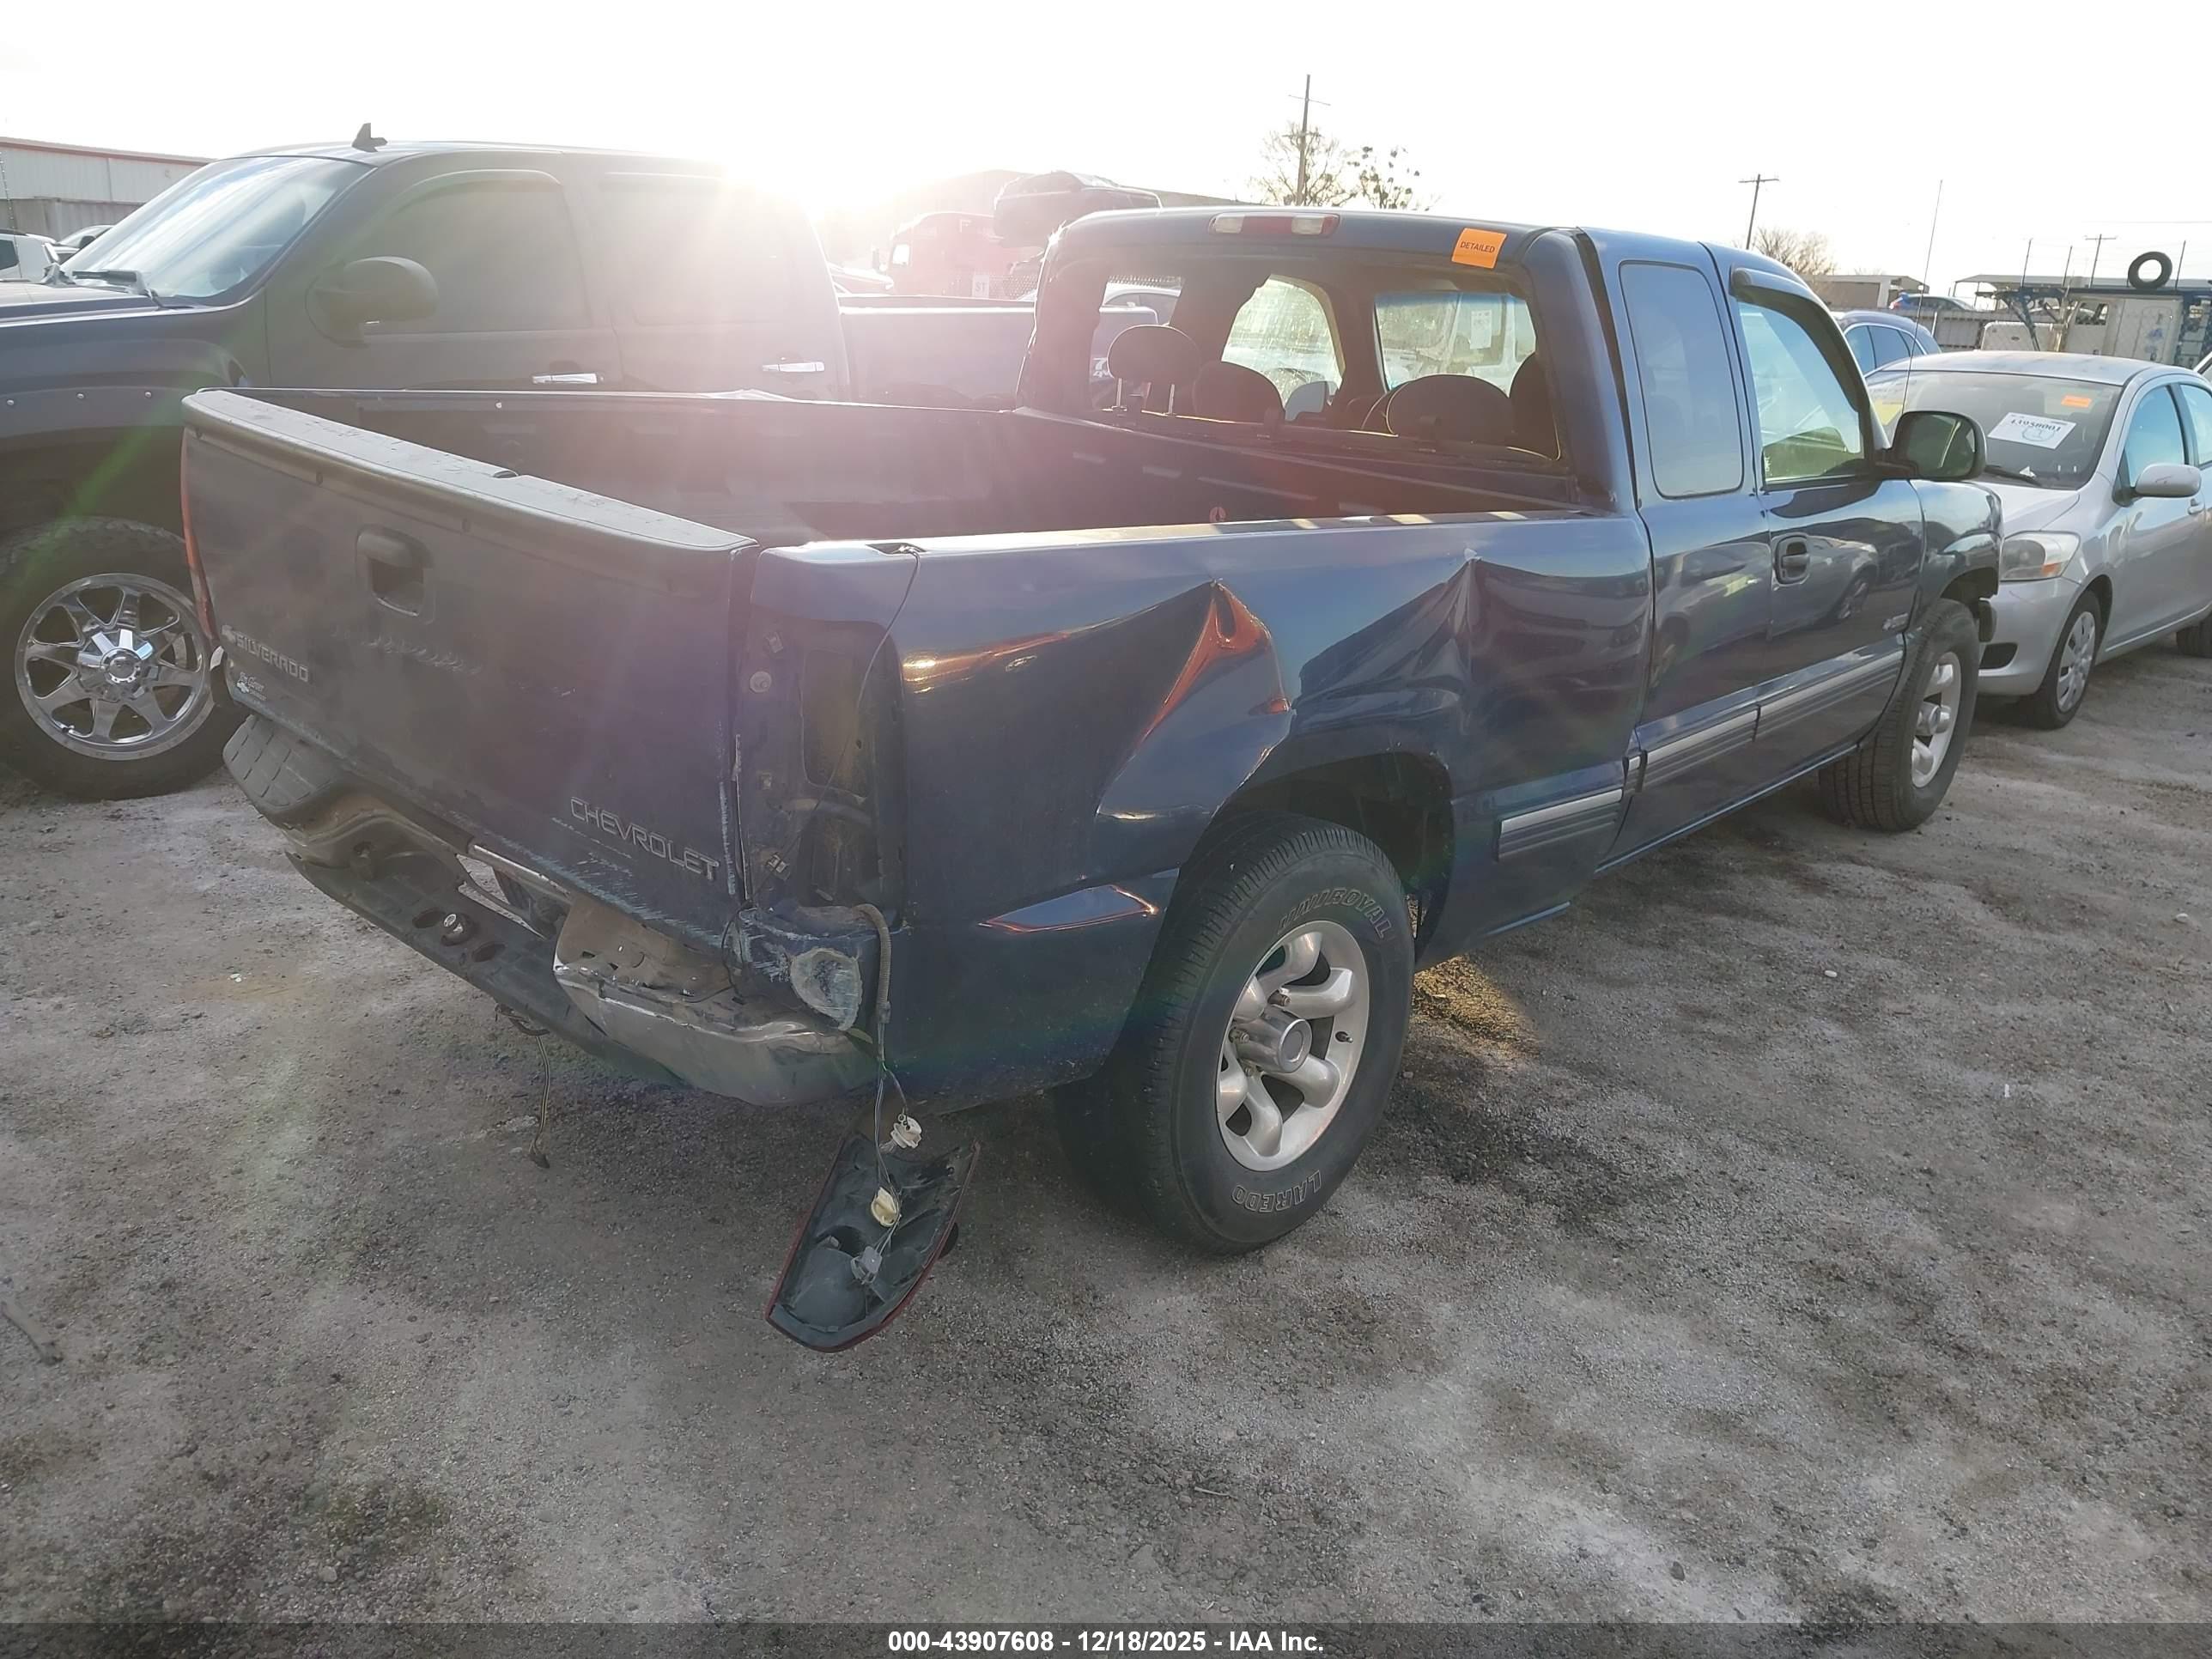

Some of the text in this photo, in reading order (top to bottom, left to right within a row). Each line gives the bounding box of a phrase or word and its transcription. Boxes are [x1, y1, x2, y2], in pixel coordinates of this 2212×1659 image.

[1460, 241, 1496, 254] DETAILED
[235, 632, 308, 683] SILVERADO
[570, 796, 720, 880] CHEVROLET
[1231, 1170, 1322, 1213] LAREDO
